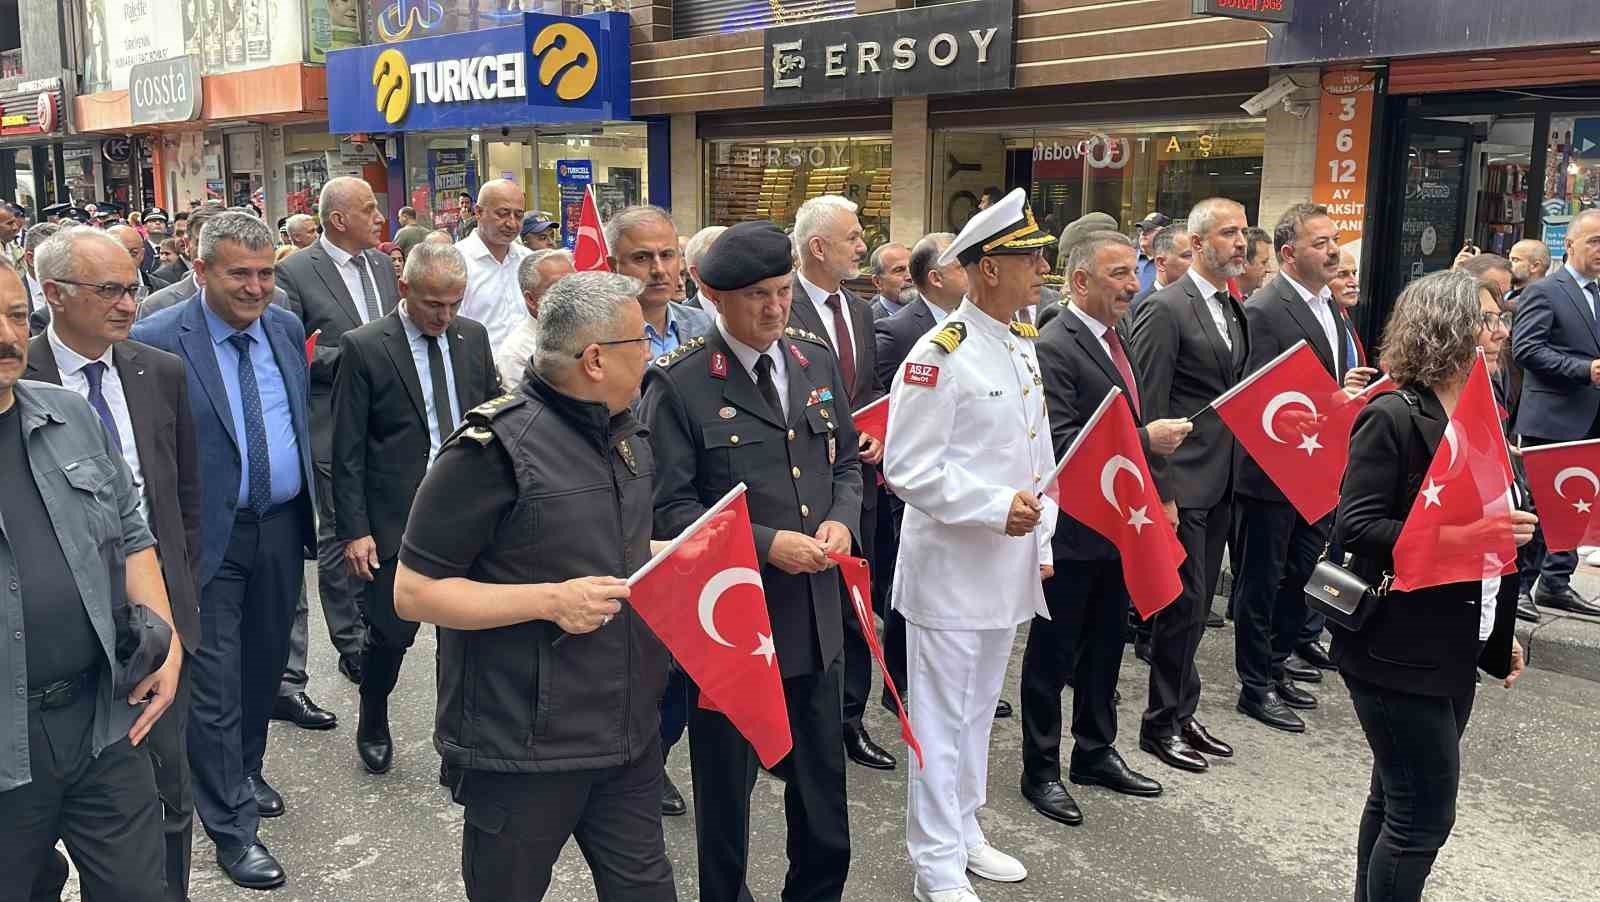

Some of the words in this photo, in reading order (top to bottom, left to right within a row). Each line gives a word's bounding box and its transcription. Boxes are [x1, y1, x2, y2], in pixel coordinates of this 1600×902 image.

[825, 28, 998, 76] ERSOY
[134, 70, 187, 108] cossta
[1339, 97, 1356, 121] 3
[1336, 128, 1353, 152] 6
[748, 147, 846, 167] ERSOY
[1328, 159, 1357, 183] 12
[1332, 189, 1351, 199] AY
